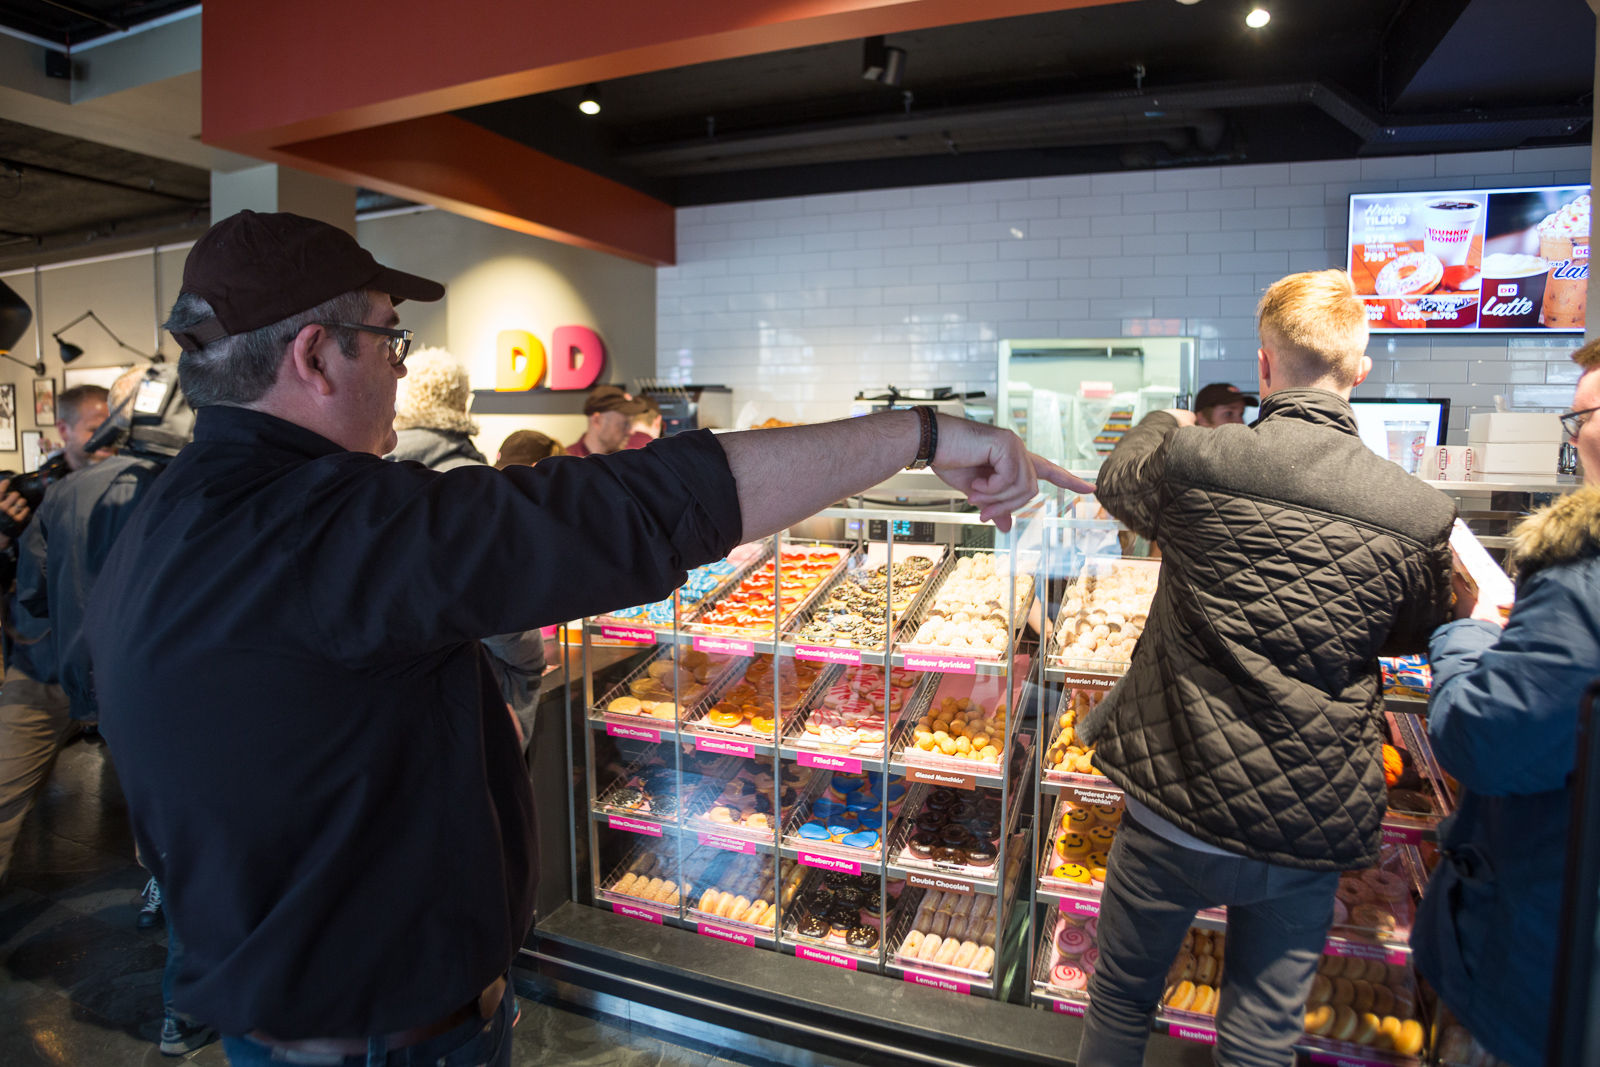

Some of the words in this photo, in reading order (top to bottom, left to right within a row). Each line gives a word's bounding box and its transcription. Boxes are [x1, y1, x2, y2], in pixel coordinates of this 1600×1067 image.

[1481, 296, 1533, 316] Latte
[604, 629, 632, 638] Manager's
[632, 631, 653, 640] Special
[698, 639, 729, 650] Raspberry
[730, 642, 748, 651] Filled
[795, 648, 828, 657] Chocolate
[829, 651, 860, 661] Sprinkles
[907, 658, 936, 667] Rainbow
[938, 660, 971, 670] Sprinkles
[612, 726, 630, 736] Apple
[630, 728, 653, 738] Crumble
[701, 740, 726, 750] Caramel
[727, 743, 748, 753] Frosted
[813, 756, 831, 765] Filled
[831, 759, 846, 767] Star
[915, 771, 934, 781] Glazed
[1074, 789, 1105, 799] Powdered
[1105, 791, 1121, 802] Jelly
[610, 818, 624, 826] White
[624, 821, 647, 830] Chocolate
[804, 855, 833, 867] Blueberry
[834, 860, 853, 870] Filled
[910, 875, 934, 886] Double
[935, 879, 970, 892] Chocolate
[622, 907, 639, 916] Sports
[639, 911, 653, 920] Crazy
[1075, 902, 1100, 913] Smiley
[704, 926, 733, 939] Powdered
[733, 932, 748, 943] Jelly
[803, 949, 830, 961] Hazelnut
[831, 955, 848, 966] Filled
[915, 976, 938, 987] Lemon
[939, 980, 957, 991] Filled
[1180, 1029, 1213, 1041] Hazelnut
